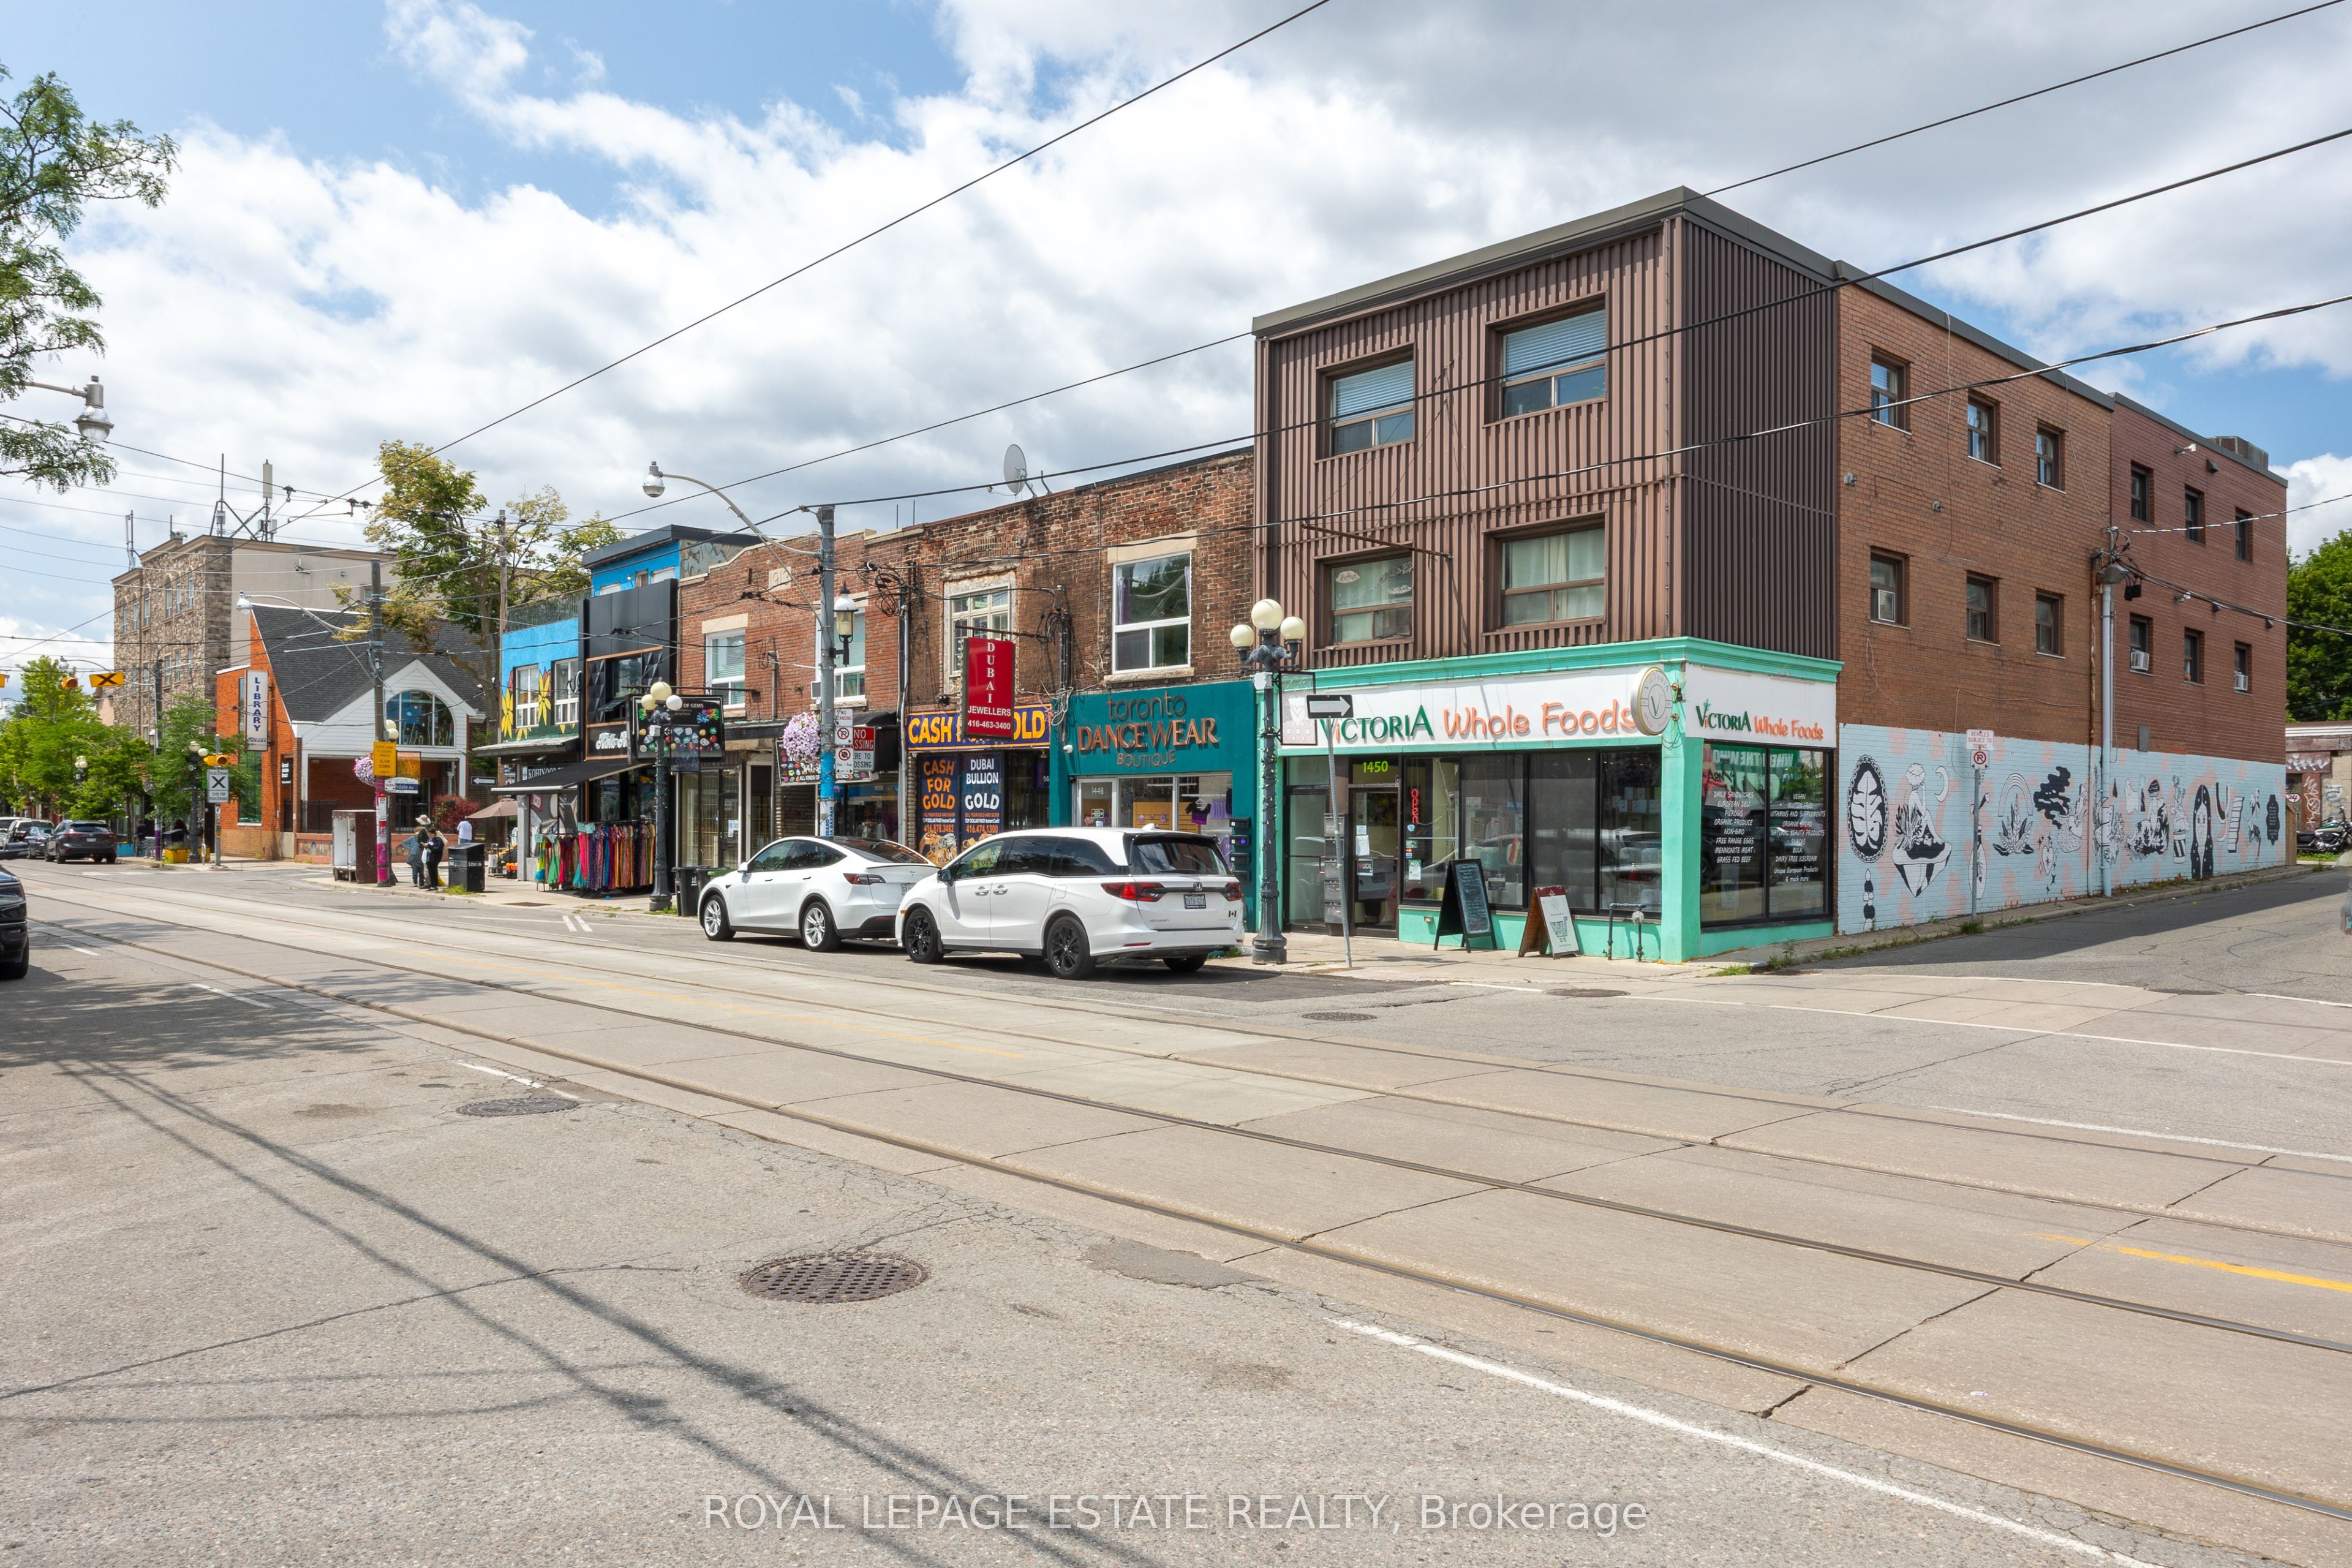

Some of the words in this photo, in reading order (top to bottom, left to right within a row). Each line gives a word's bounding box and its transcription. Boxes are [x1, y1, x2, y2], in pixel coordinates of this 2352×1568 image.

[986, 642, 995, 703] DUBAI
[253, 677, 262, 731] LIBRARY
[968, 706, 1011, 716] JEWELLERS
[1107, 691, 1187, 720] toronto
[967, 720, 1011, 729] 416-463-3400
[1444, 705, 1529, 736] Whole
[1540, 699, 1636, 732] Foods
[853, 729, 866, 739] NO
[908, 716, 952, 744] CASH
[1013, 710, 1046, 740] OLD
[1078, 717, 1219, 751] DANCEWEAR
[1754, 715, 1789, 736] Whole
[1791, 719, 1823, 739] Foods
[854, 740, 873, 749] SSING
[970, 758, 994, 771] DUBAI
[1117, 750, 1176, 767] BOUTIQUE
[1362, 761, 1389, 773] 1450
[923, 759, 956, 776] CASH
[927, 777, 951, 793] FOR
[966, 772, 999, 785] BULLION
[922, 793, 956, 810] GOLD
[965, 793, 1000, 810] GOLD
